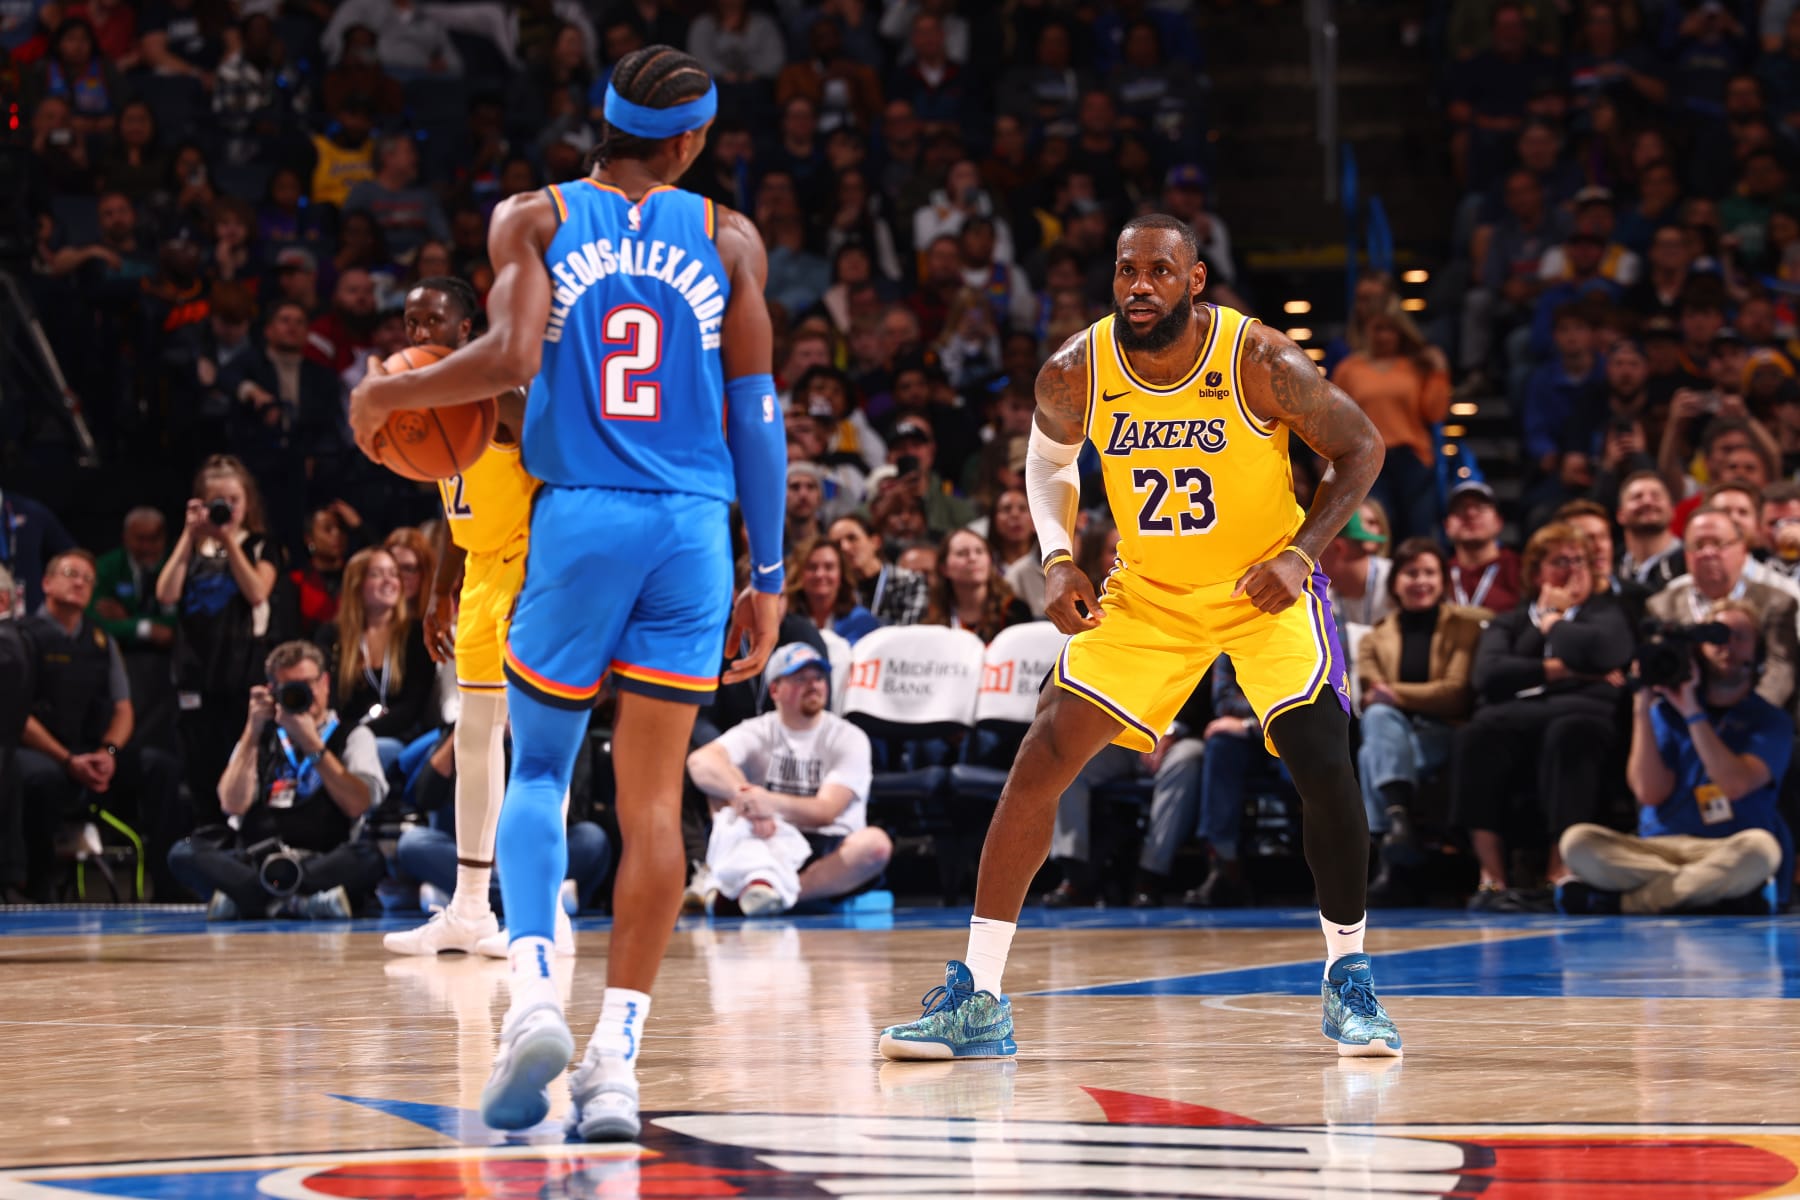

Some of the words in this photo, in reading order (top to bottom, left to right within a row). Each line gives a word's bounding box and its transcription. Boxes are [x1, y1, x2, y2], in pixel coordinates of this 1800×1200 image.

[601, 302, 663, 422] 2
[1199, 388, 1230, 400] bibigo
[1103, 412, 1228, 456] LAKERS
[446, 473, 474, 519] 2
[1131, 467, 1219, 537] 23
